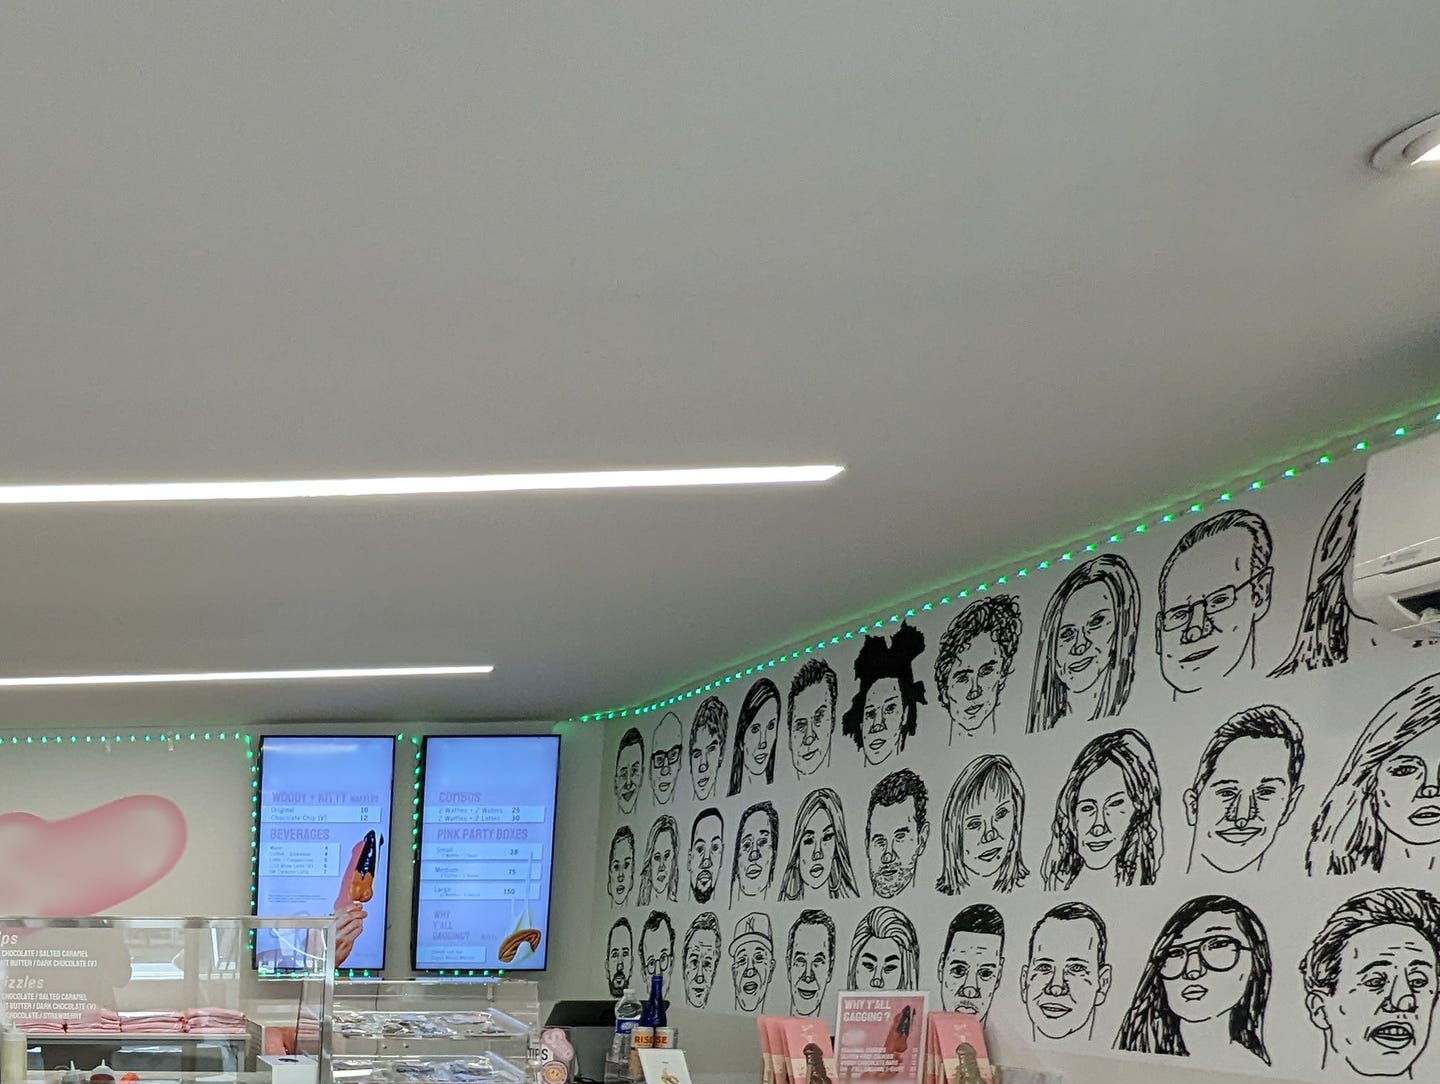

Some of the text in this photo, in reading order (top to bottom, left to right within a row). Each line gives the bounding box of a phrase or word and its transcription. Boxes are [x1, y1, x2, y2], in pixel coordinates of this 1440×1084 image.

[270, 828, 330, 840] BEVERAGES
[437, 828, 529, 840] PINK PARTY BOXES
[10, 959, 32, 967] BUTTER
[36, 959, 52, 967] DARK
[60, 993, 87, 1001] CARAMEL
[52, 1002, 86, 1010] CHOCOLATE
[844, 1000, 891, 1009] WHY Y'ALL
[529, 1048, 549, 1061] TIPS
